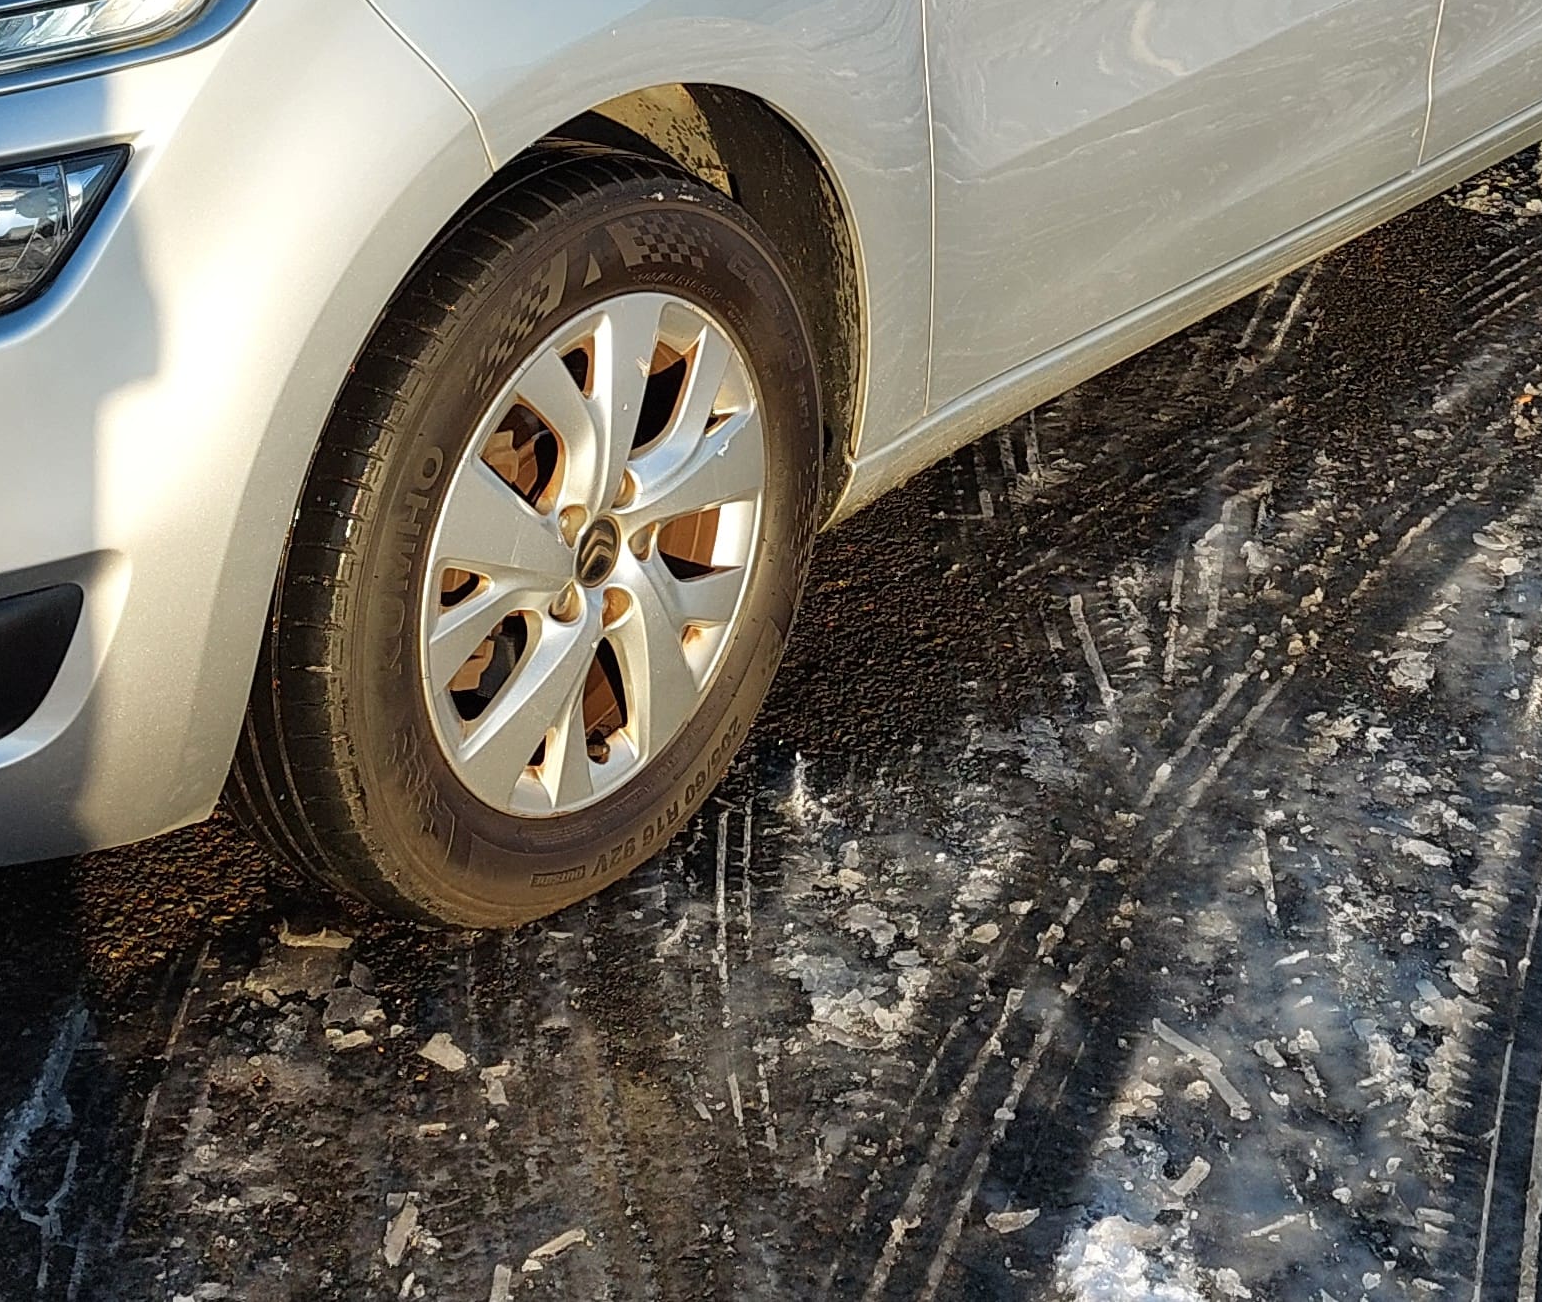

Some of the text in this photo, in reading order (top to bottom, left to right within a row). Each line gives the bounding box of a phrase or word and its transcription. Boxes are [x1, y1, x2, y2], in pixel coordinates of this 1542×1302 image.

[684, 715, 742, 807] 205/60
[642, 800, 680, 847] R16
[591, 836, 636, 877] 92V
